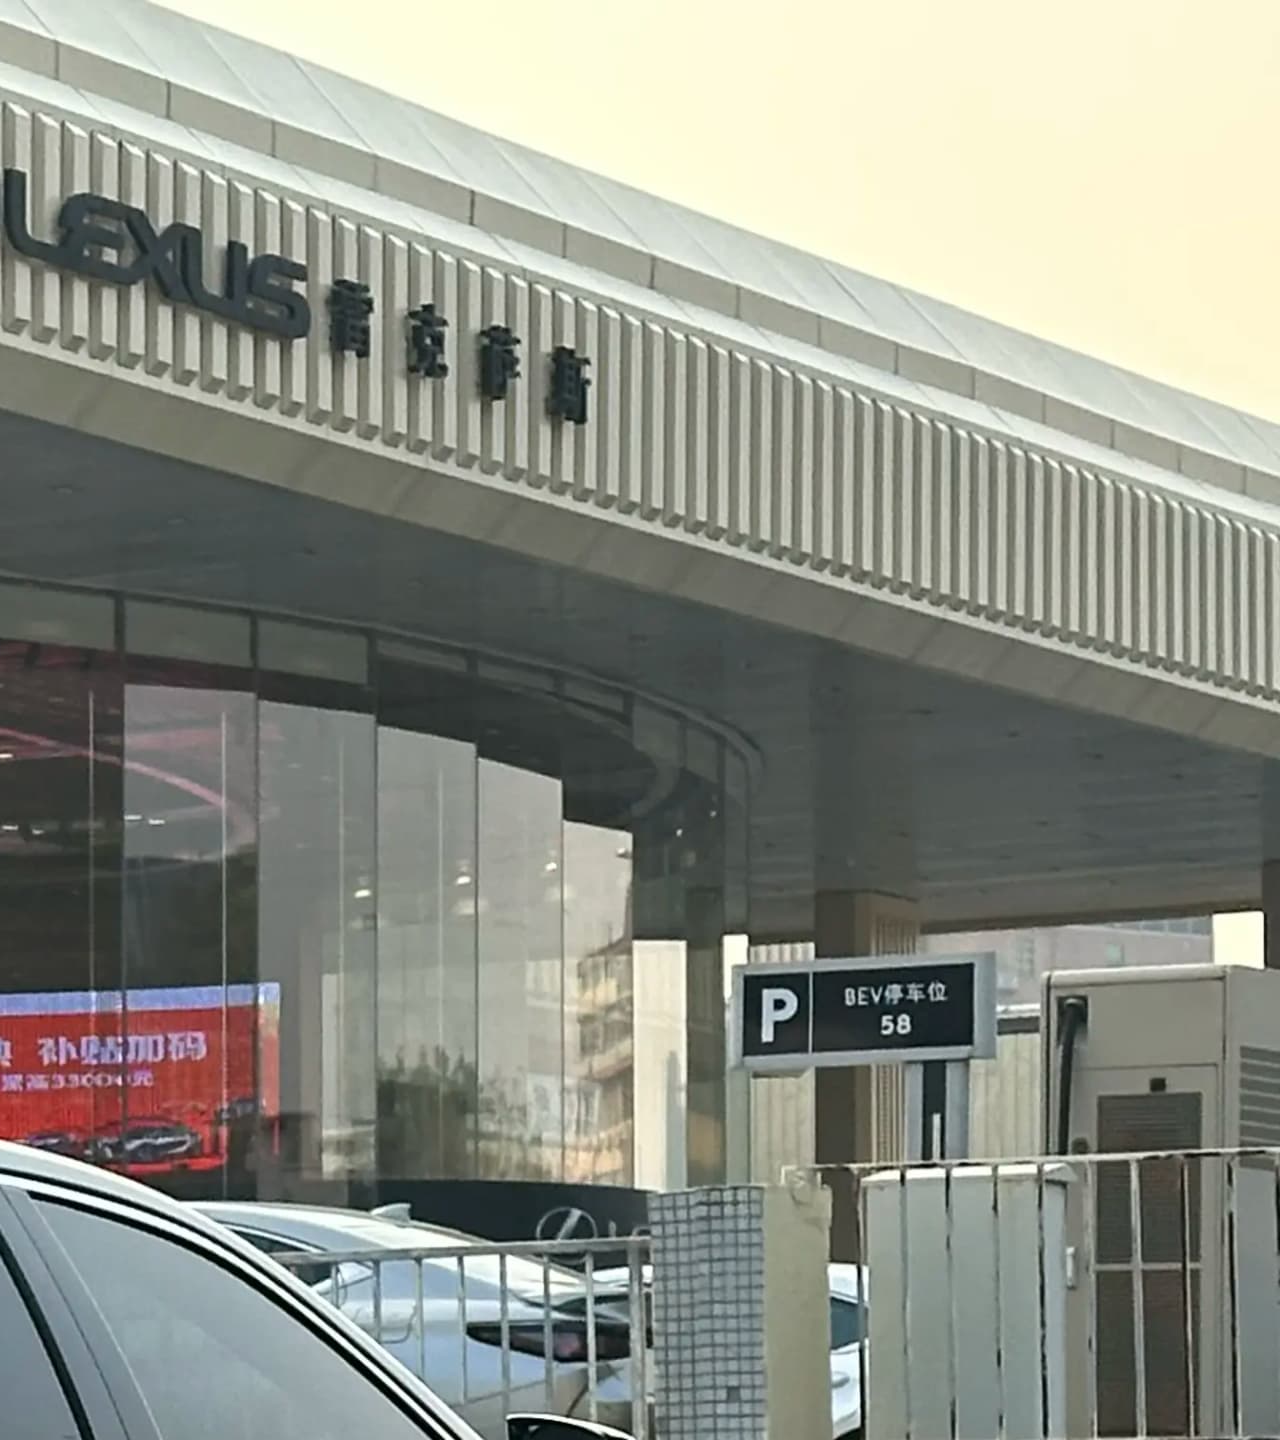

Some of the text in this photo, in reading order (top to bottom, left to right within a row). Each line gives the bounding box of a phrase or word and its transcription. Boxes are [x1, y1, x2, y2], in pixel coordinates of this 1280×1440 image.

[2, 167, 310, 339] LEXUS
[844, 981, 948, 1006] BEV停车位
[760, 987, 799, 1043] P
[880, 1014, 913, 1035] 58
[37, 1031, 208, 1067] 补贴加码
